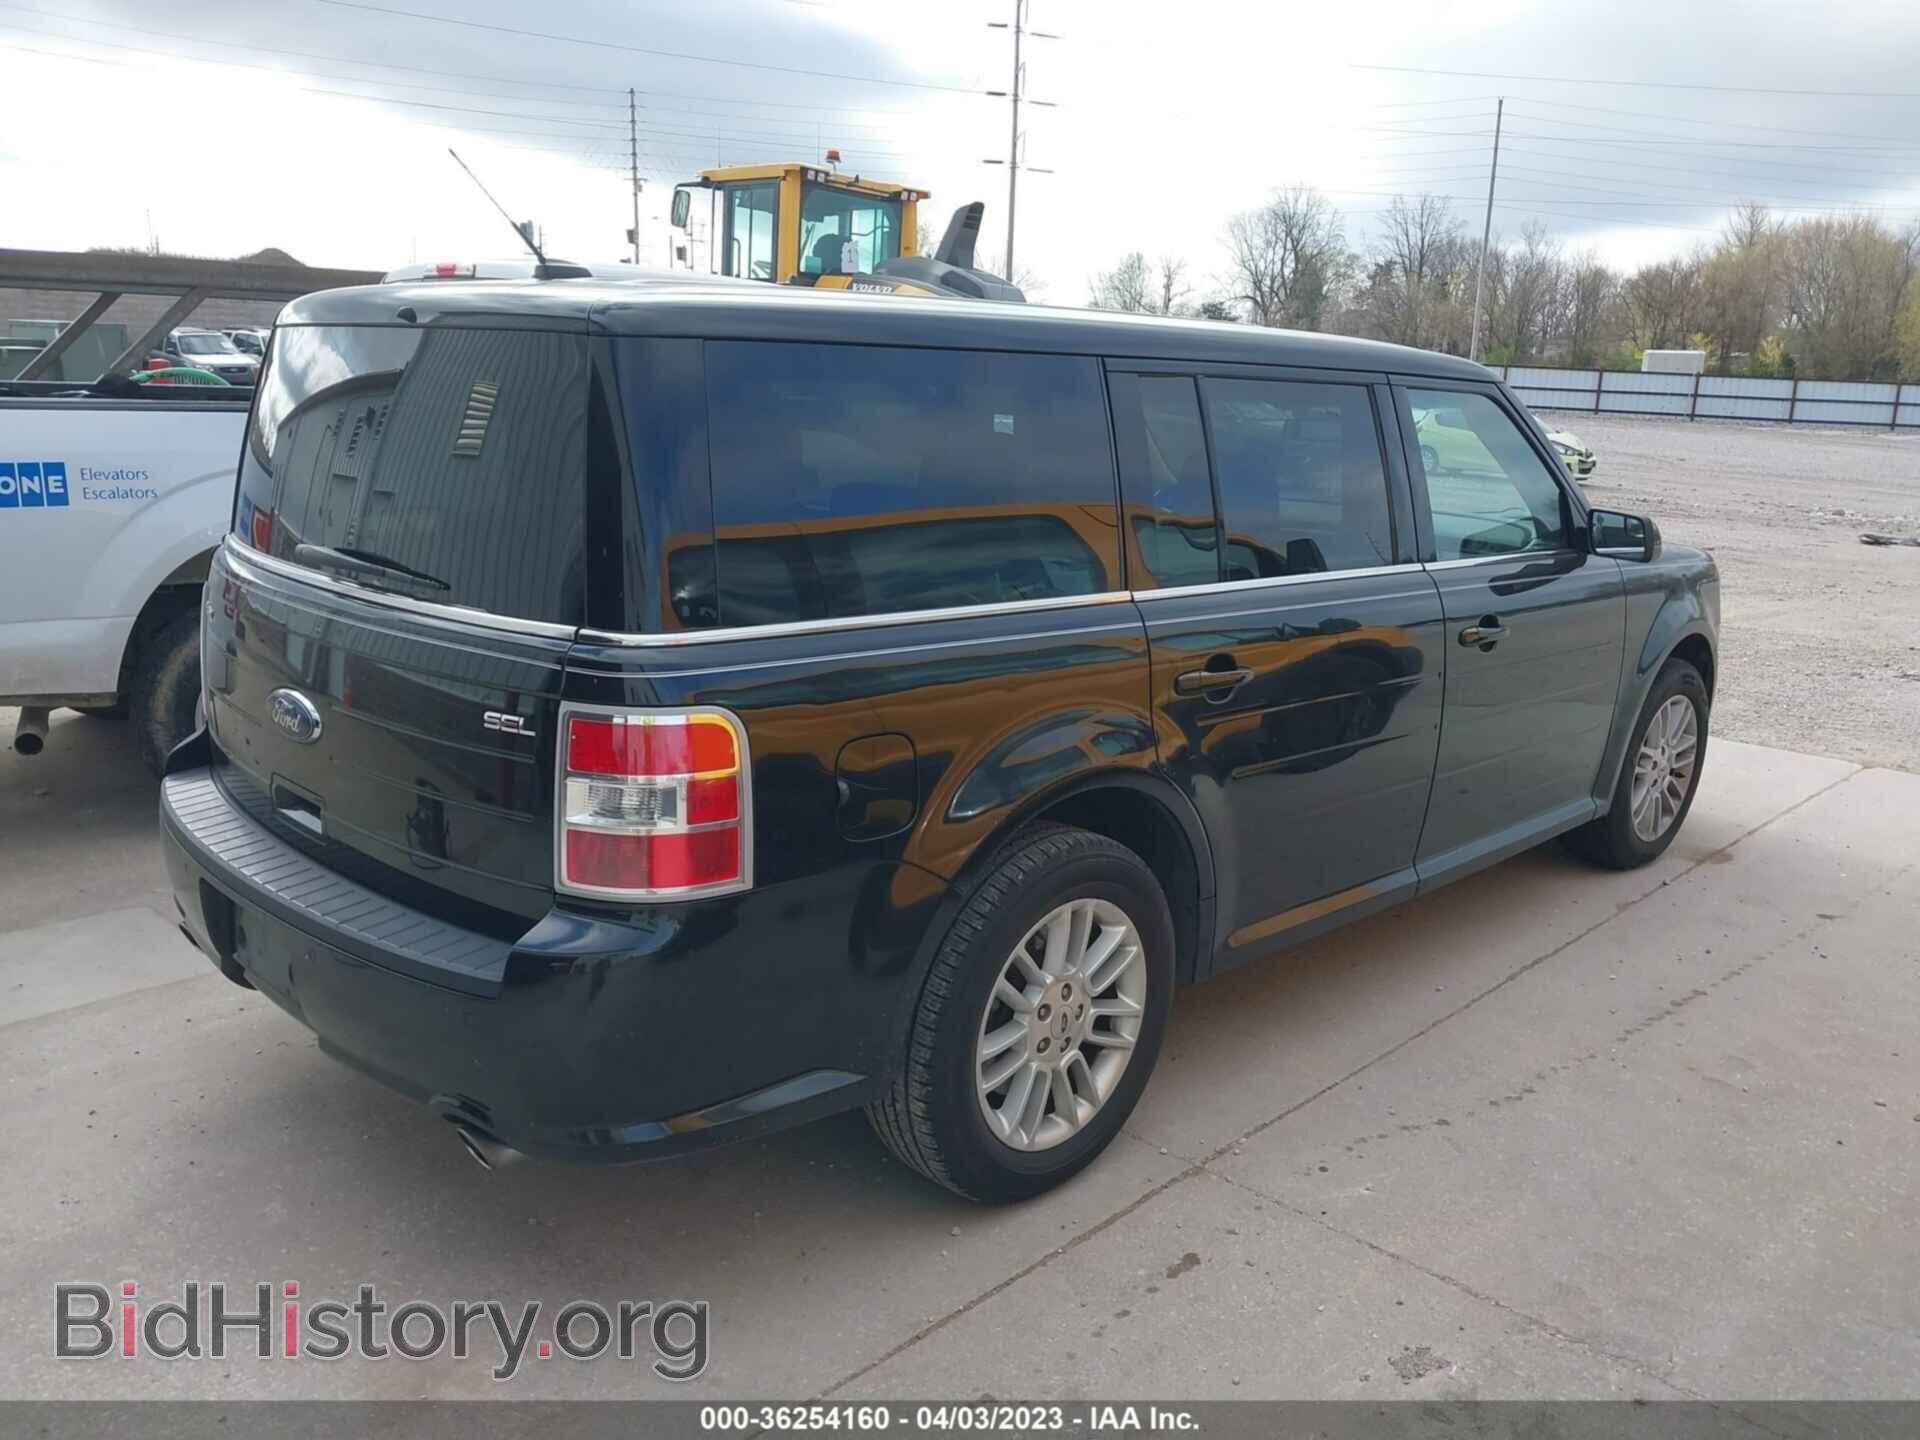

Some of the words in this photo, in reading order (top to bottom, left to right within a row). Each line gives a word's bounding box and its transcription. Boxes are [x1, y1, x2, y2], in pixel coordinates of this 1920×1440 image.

[80, 467, 149, 481] Elevators
[82, 486, 158, 500] Escalators
[272, 697, 301, 733] Ford
[483, 711, 536, 736] SEL
